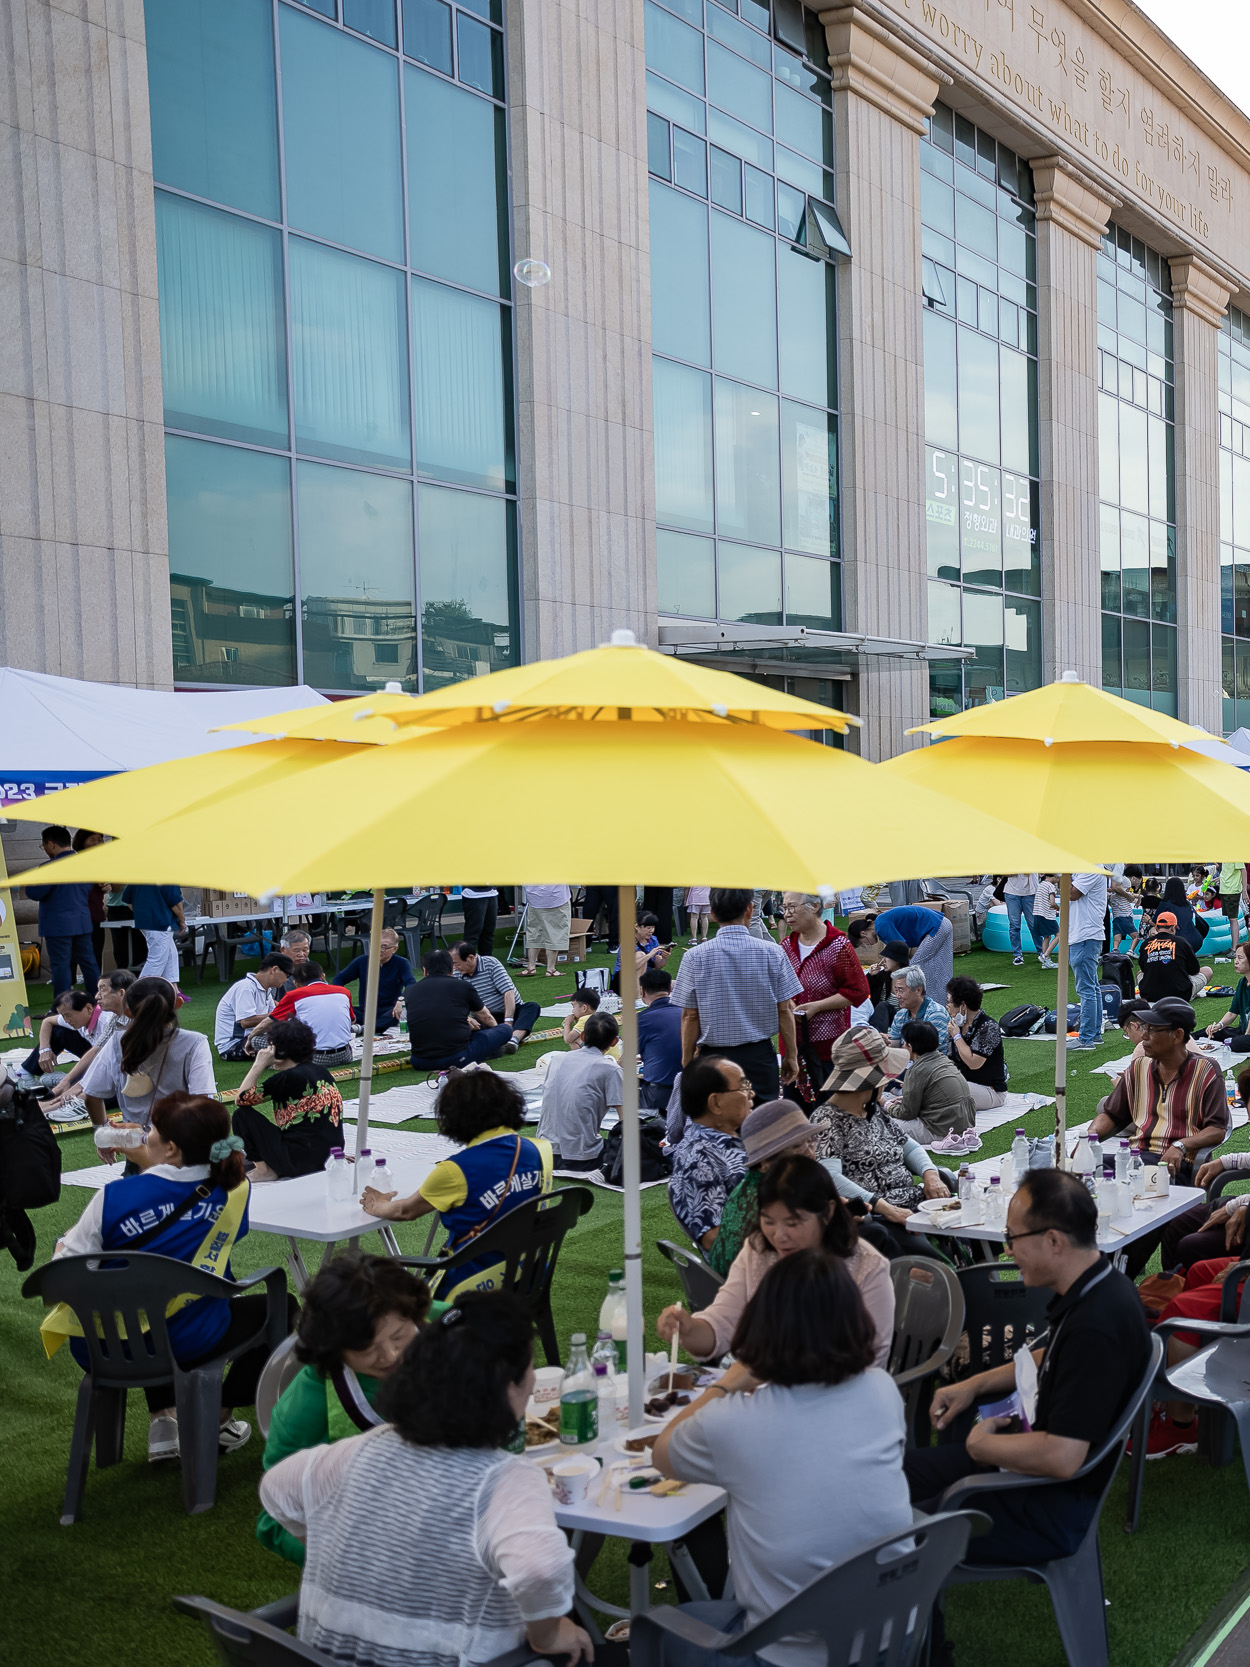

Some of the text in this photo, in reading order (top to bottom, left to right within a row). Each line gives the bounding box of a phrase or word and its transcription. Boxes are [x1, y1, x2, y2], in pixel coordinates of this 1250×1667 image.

[922, 0, 983, 69] worry
[990, 51, 1043, 112] about
[1048, 98, 1089, 147] what
[1093, 131, 1108, 161] to
[1112, 144, 1129, 177] do
[1134, 160, 1155, 197] for
[1157, 184, 1187, 222] your
[1189, 203, 1209, 239] life
[1028, 5, 1090, 92] 무엇을
[1098, 67, 1131, 130] 할지
[1140, 107, 1201, 188] 염려하지
[1207, 164, 1234, 214] 말라
[926, 503, 953, 522] 스포츠
[933, 451, 1029, 521] 5:35:32
[964, 511, 1036, 544] 정형외과 내과의원
